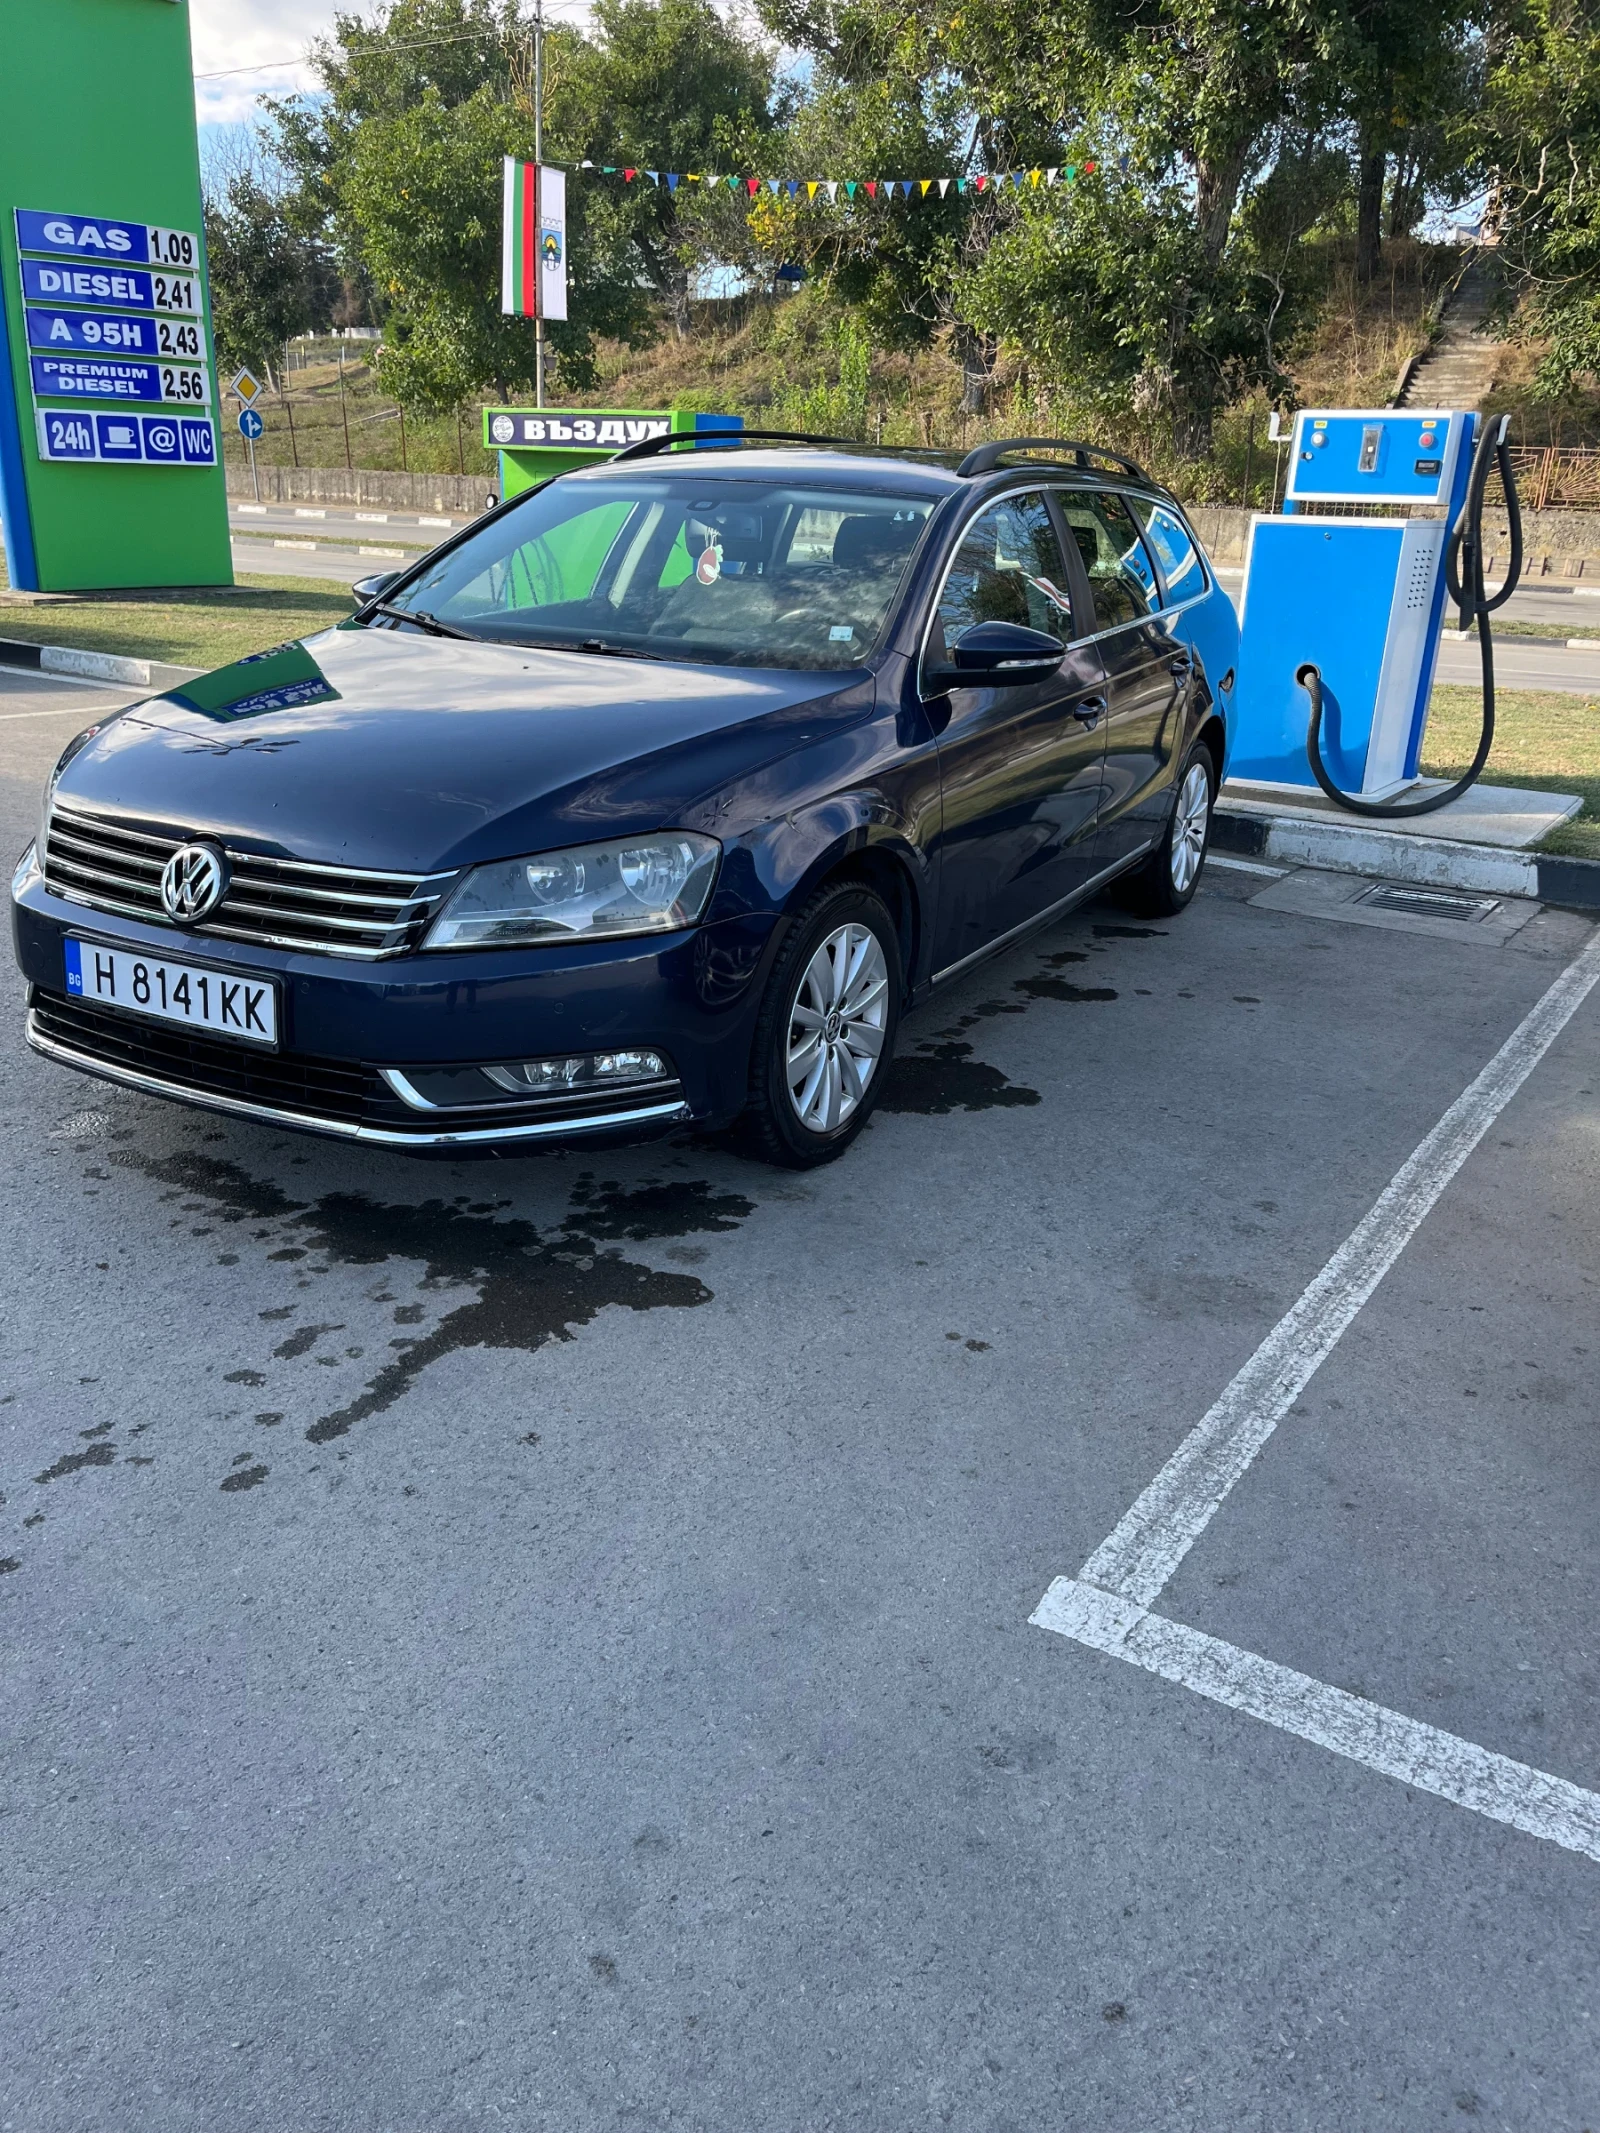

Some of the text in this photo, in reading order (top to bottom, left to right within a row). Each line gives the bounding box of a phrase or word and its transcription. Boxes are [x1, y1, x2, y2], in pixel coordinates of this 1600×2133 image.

[43, 221, 132, 251] GAS
[39, 269, 144, 301] DIESEL
[43, 362, 149, 379] PREMIUM
[58, 376, 141, 395] DIESEL
[51, 420, 91, 451] 24h
[184, 427, 211, 455] WC
[523, 419, 669, 445] ВЪЗДУХ
[68, 972, 82, 987] BG
